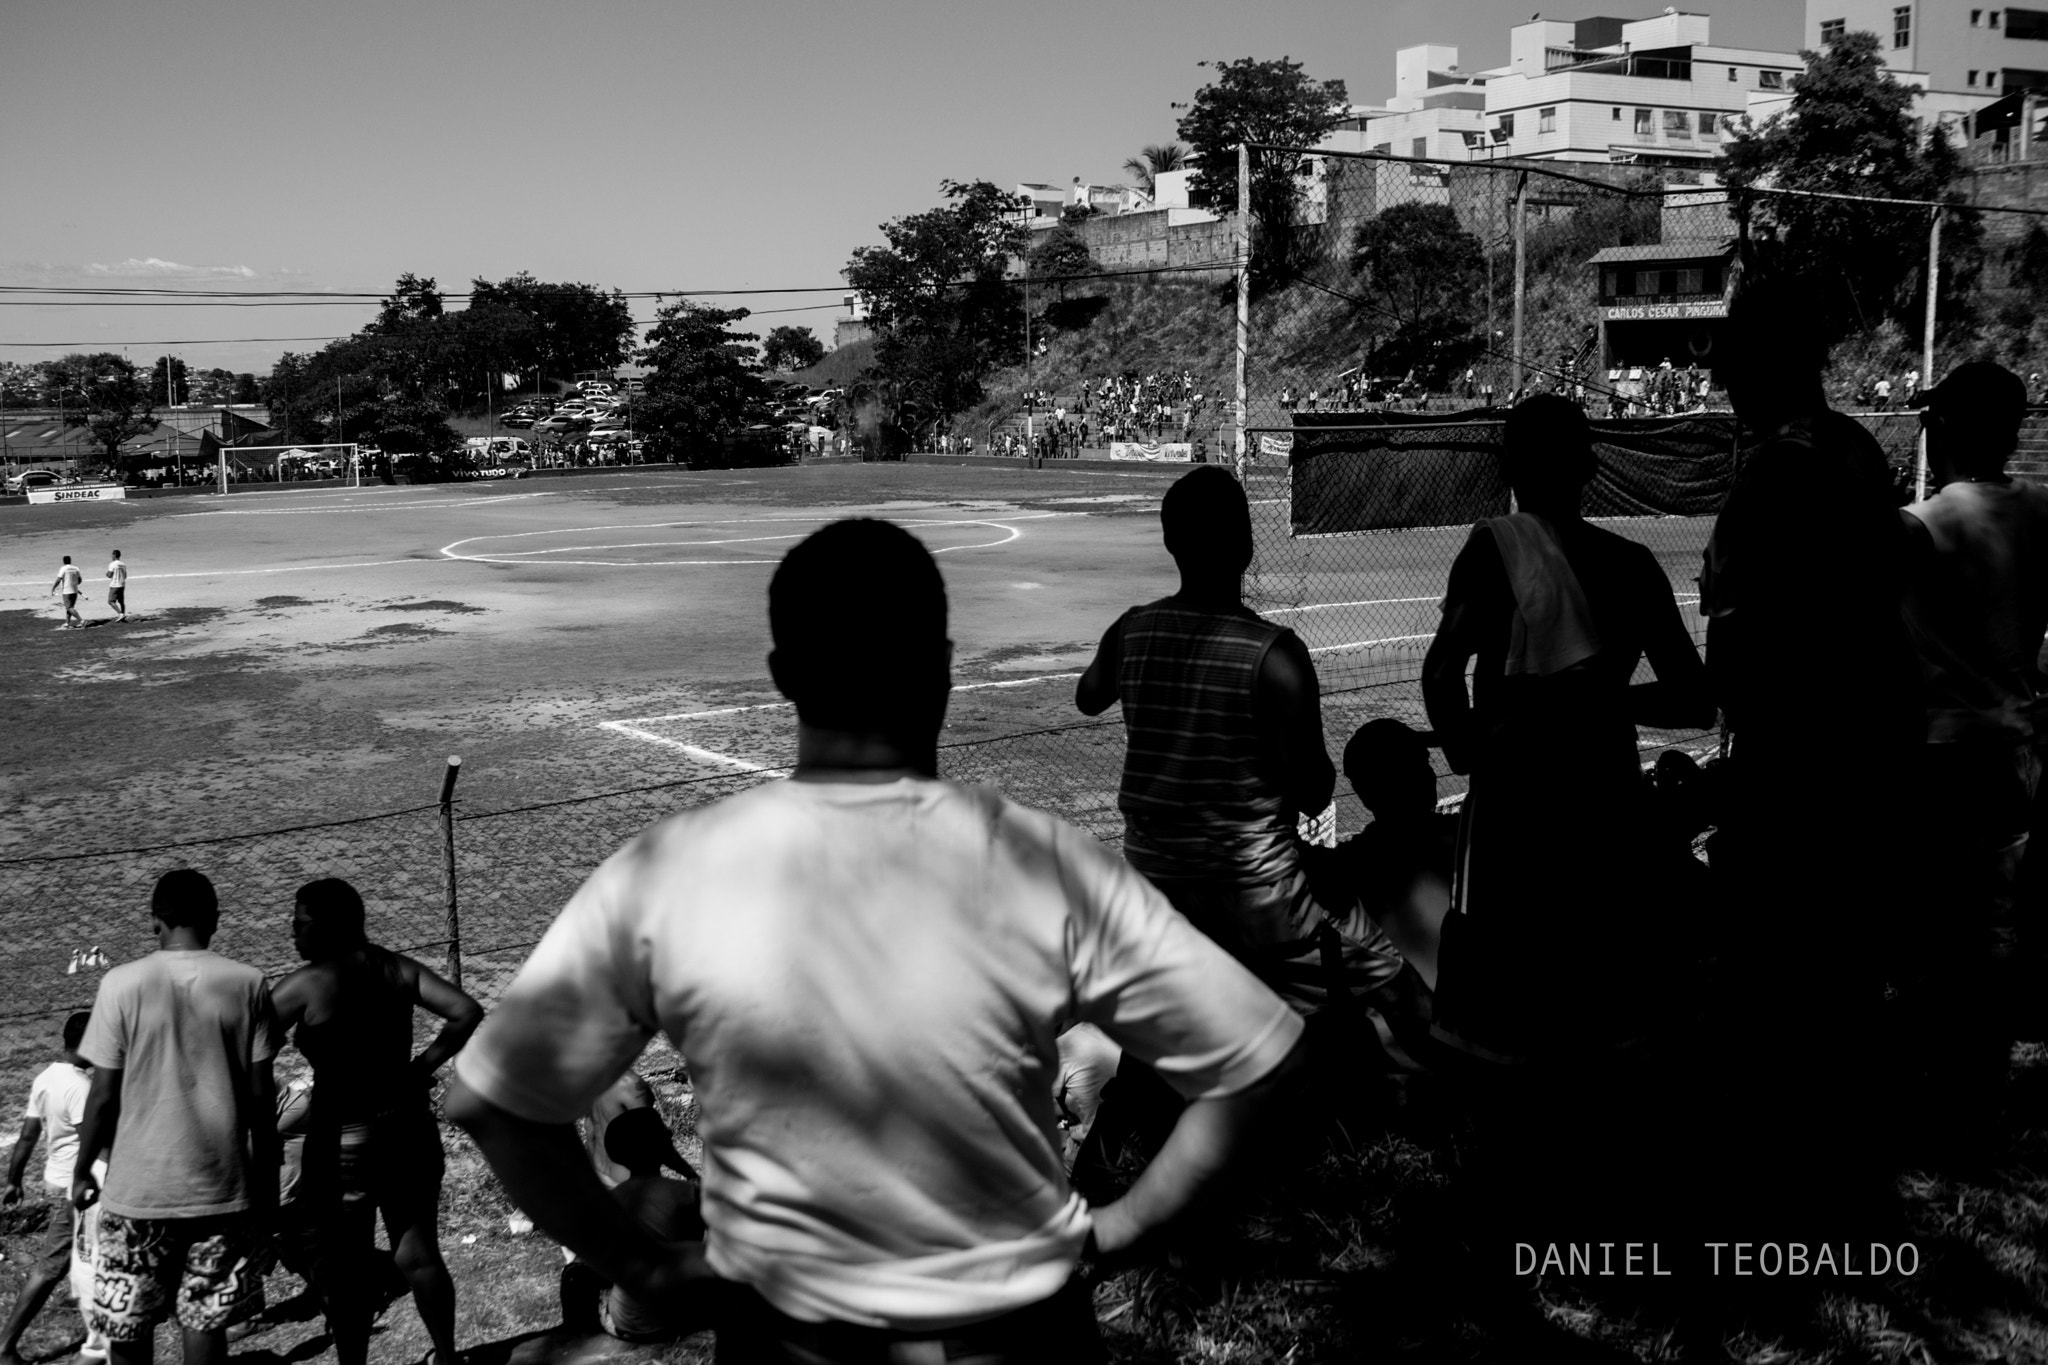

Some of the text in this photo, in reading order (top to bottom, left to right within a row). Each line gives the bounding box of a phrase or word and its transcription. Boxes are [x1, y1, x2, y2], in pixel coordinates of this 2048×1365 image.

[1659, 295, 1674, 306] DE
[1608, 307, 1645, 319] CARLOS
[479, 468, 506, 477] TUDO
[54, 490, 100, 501] SINDEAC
